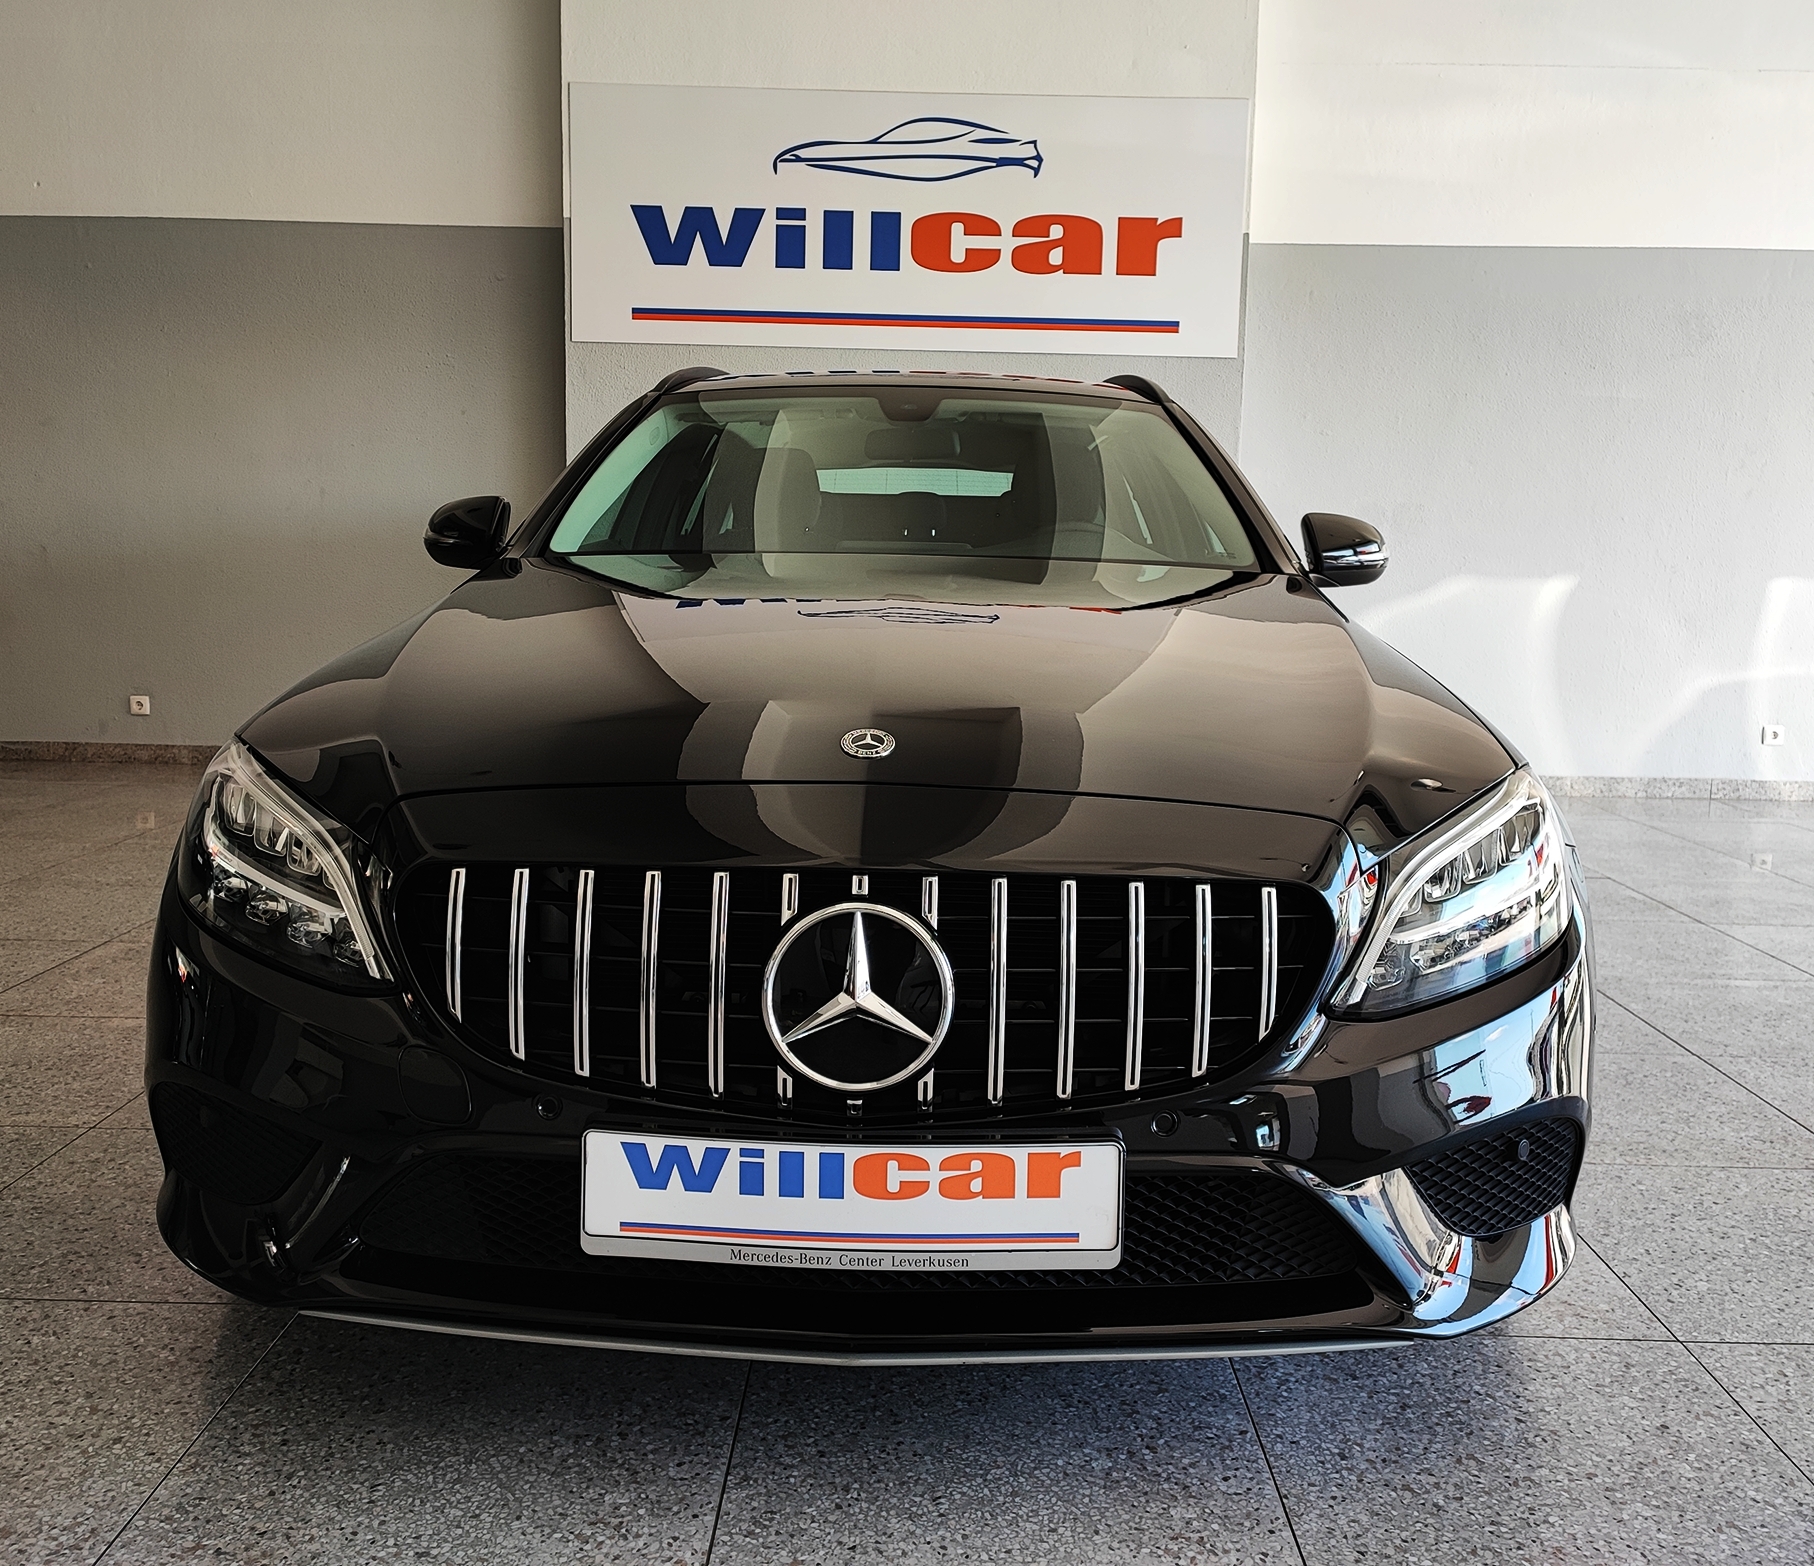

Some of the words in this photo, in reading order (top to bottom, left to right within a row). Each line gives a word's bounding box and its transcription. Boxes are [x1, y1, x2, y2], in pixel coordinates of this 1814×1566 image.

[729, 1248, 832, 1266] Mercedes-Benz
[839, 1253, 885, 1268] Center
[891, 1255, 970, 1268] Leverkusen
